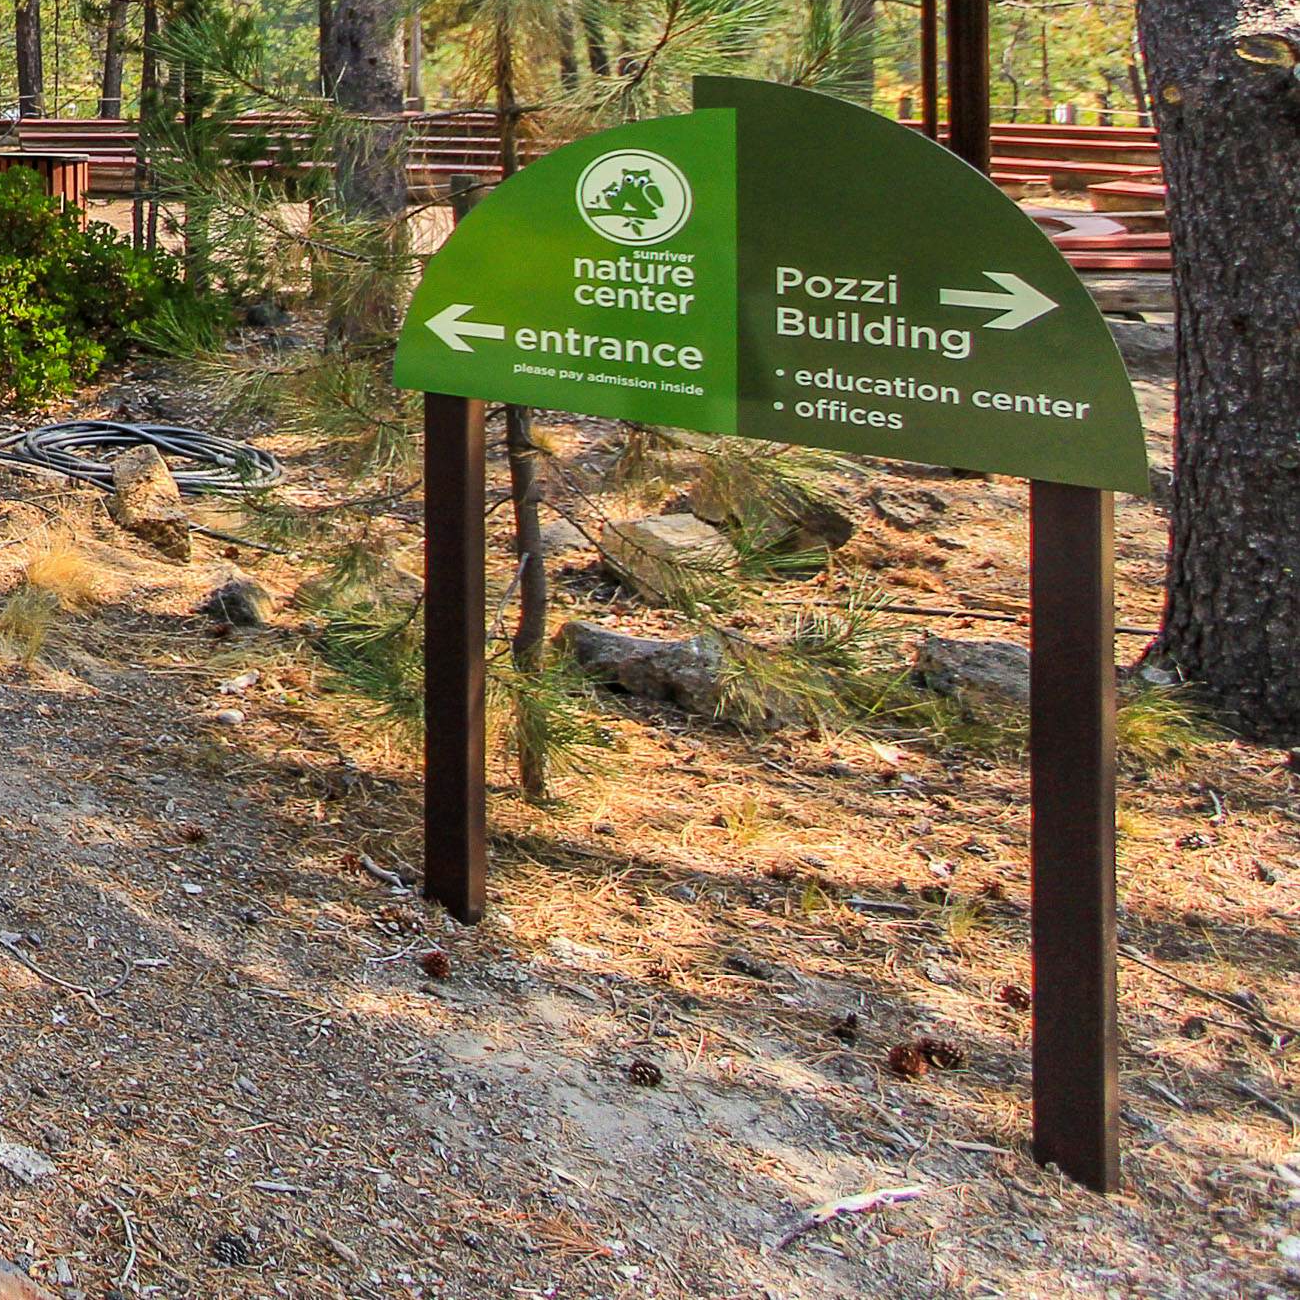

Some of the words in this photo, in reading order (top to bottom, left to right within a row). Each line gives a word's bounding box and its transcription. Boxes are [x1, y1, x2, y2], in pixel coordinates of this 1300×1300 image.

[573, 256, 695, 288] nature
[632, 250, 695, 263] sunriver
[573, 284, 695, 315] center
[775, 266, 898, 305] Pozzi
[514, 327, 704, 371] entrance
[775, 305, 972, 360] Building
[513, 363, 556, 378] please
[558, 370, 584, 382] pay
[587, 371, 657, 390] admission
[660, 380, 704, 396] inside
[794, 367, 960, 405] education
[971, 390, 1091, 420] center
[794, 398, 904, 430] offices
